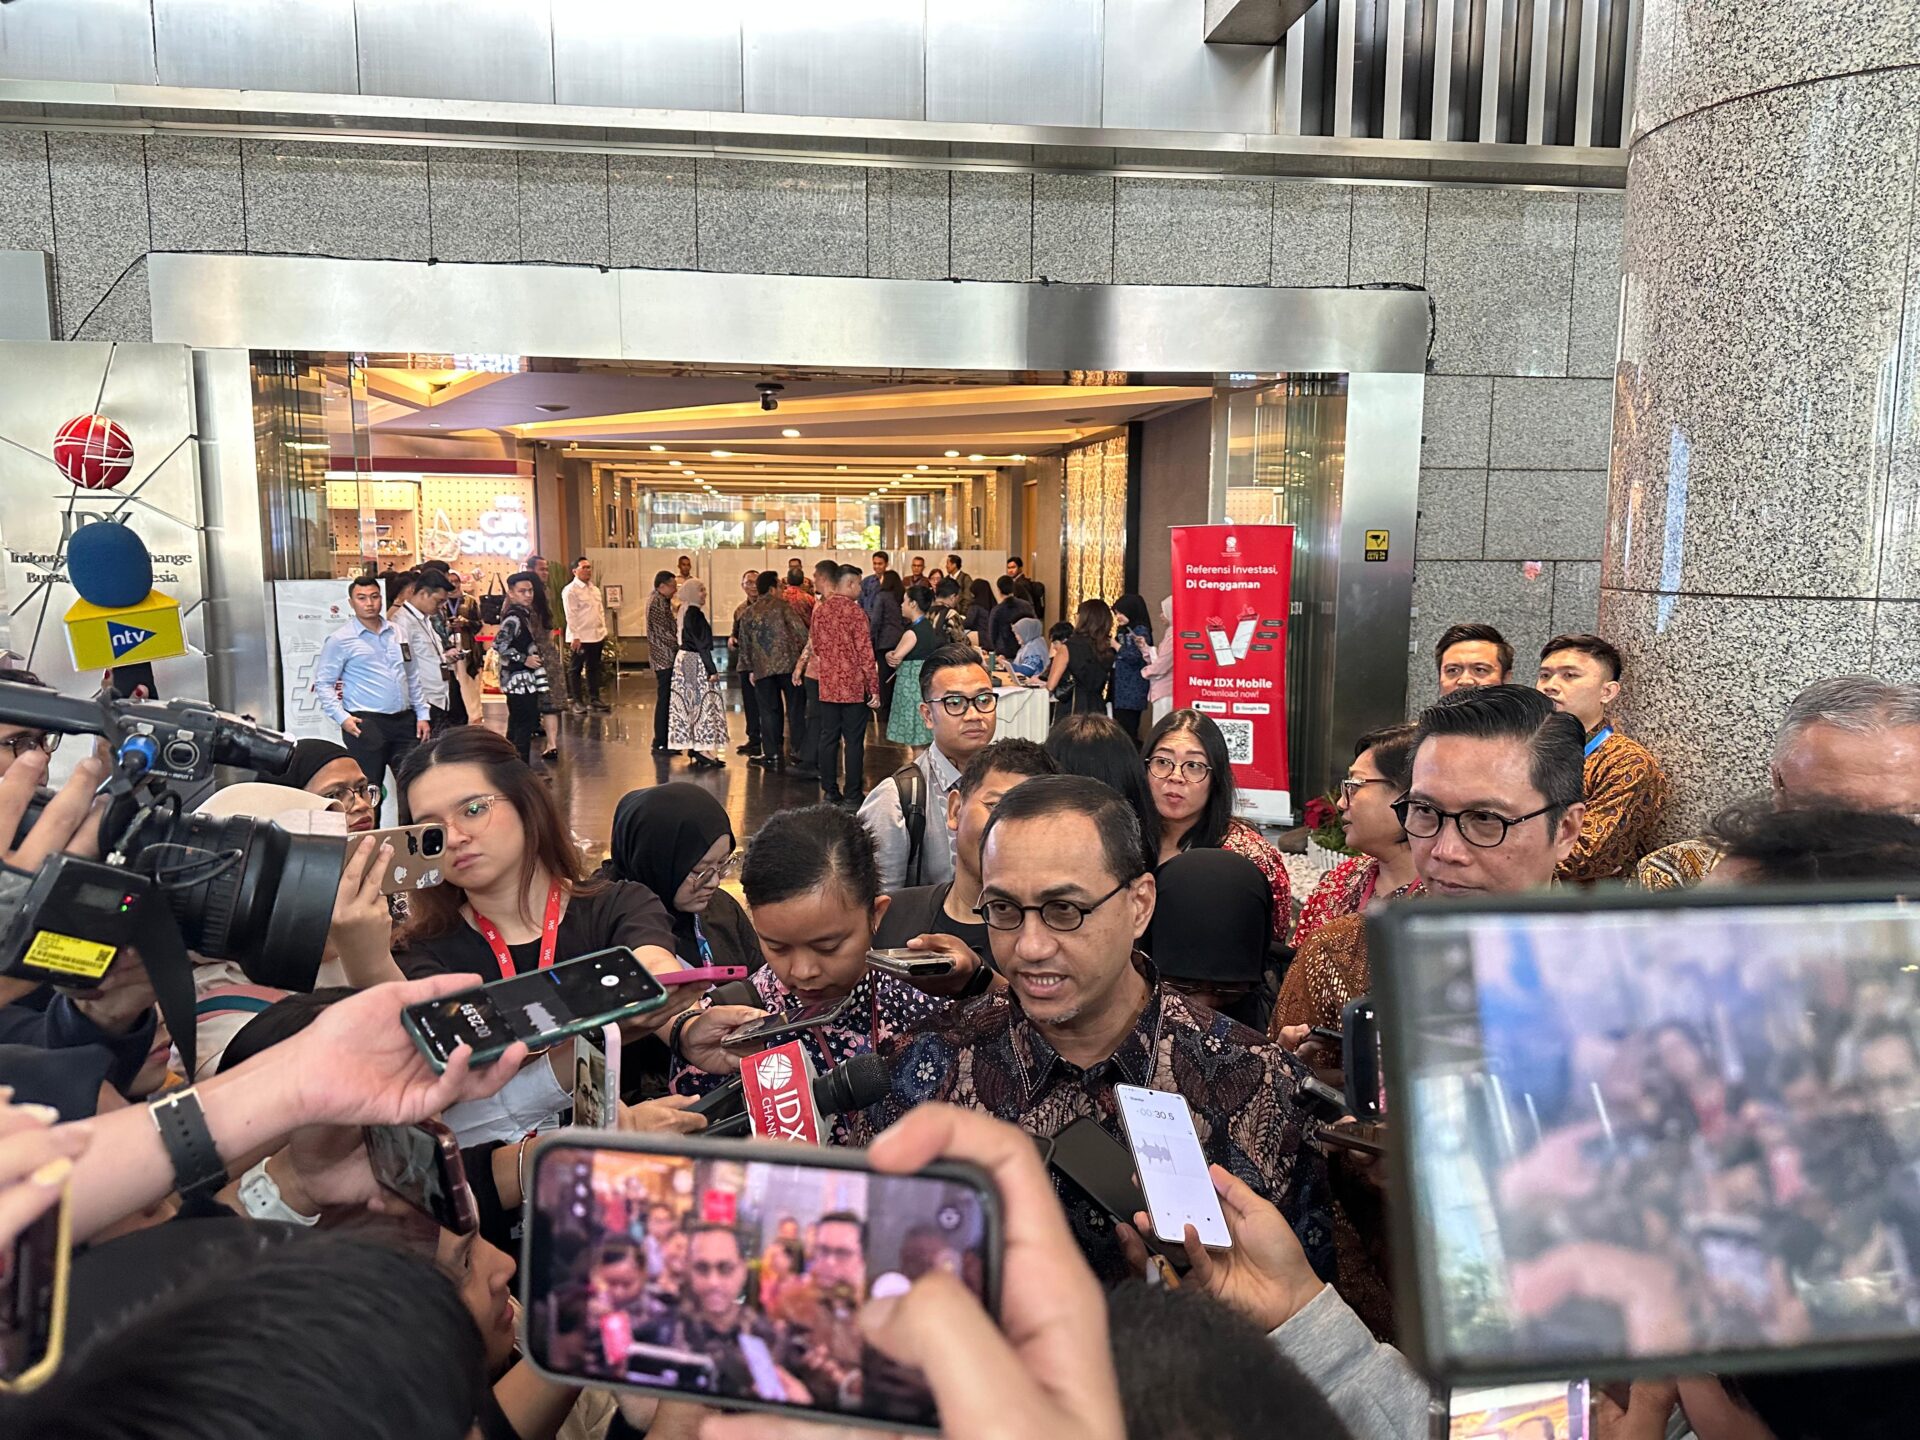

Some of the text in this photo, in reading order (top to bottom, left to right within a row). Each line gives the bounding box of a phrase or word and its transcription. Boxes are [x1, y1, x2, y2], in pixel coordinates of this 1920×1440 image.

[480, 511, 528, 534] Gift
[1185, 564, 1279, 575] Referensi Investasi,
[1185, 579, 1261, 592] Di Genggaman
[112, 629, 146, 647] ntv
[1188, 676, 1273, 689] New IDX Mobile
[1201, 688, 1260, 698] Download now!
[761, 1097, 779, 1141] CHANN
[774, 1088, 807, 1142] IDX
